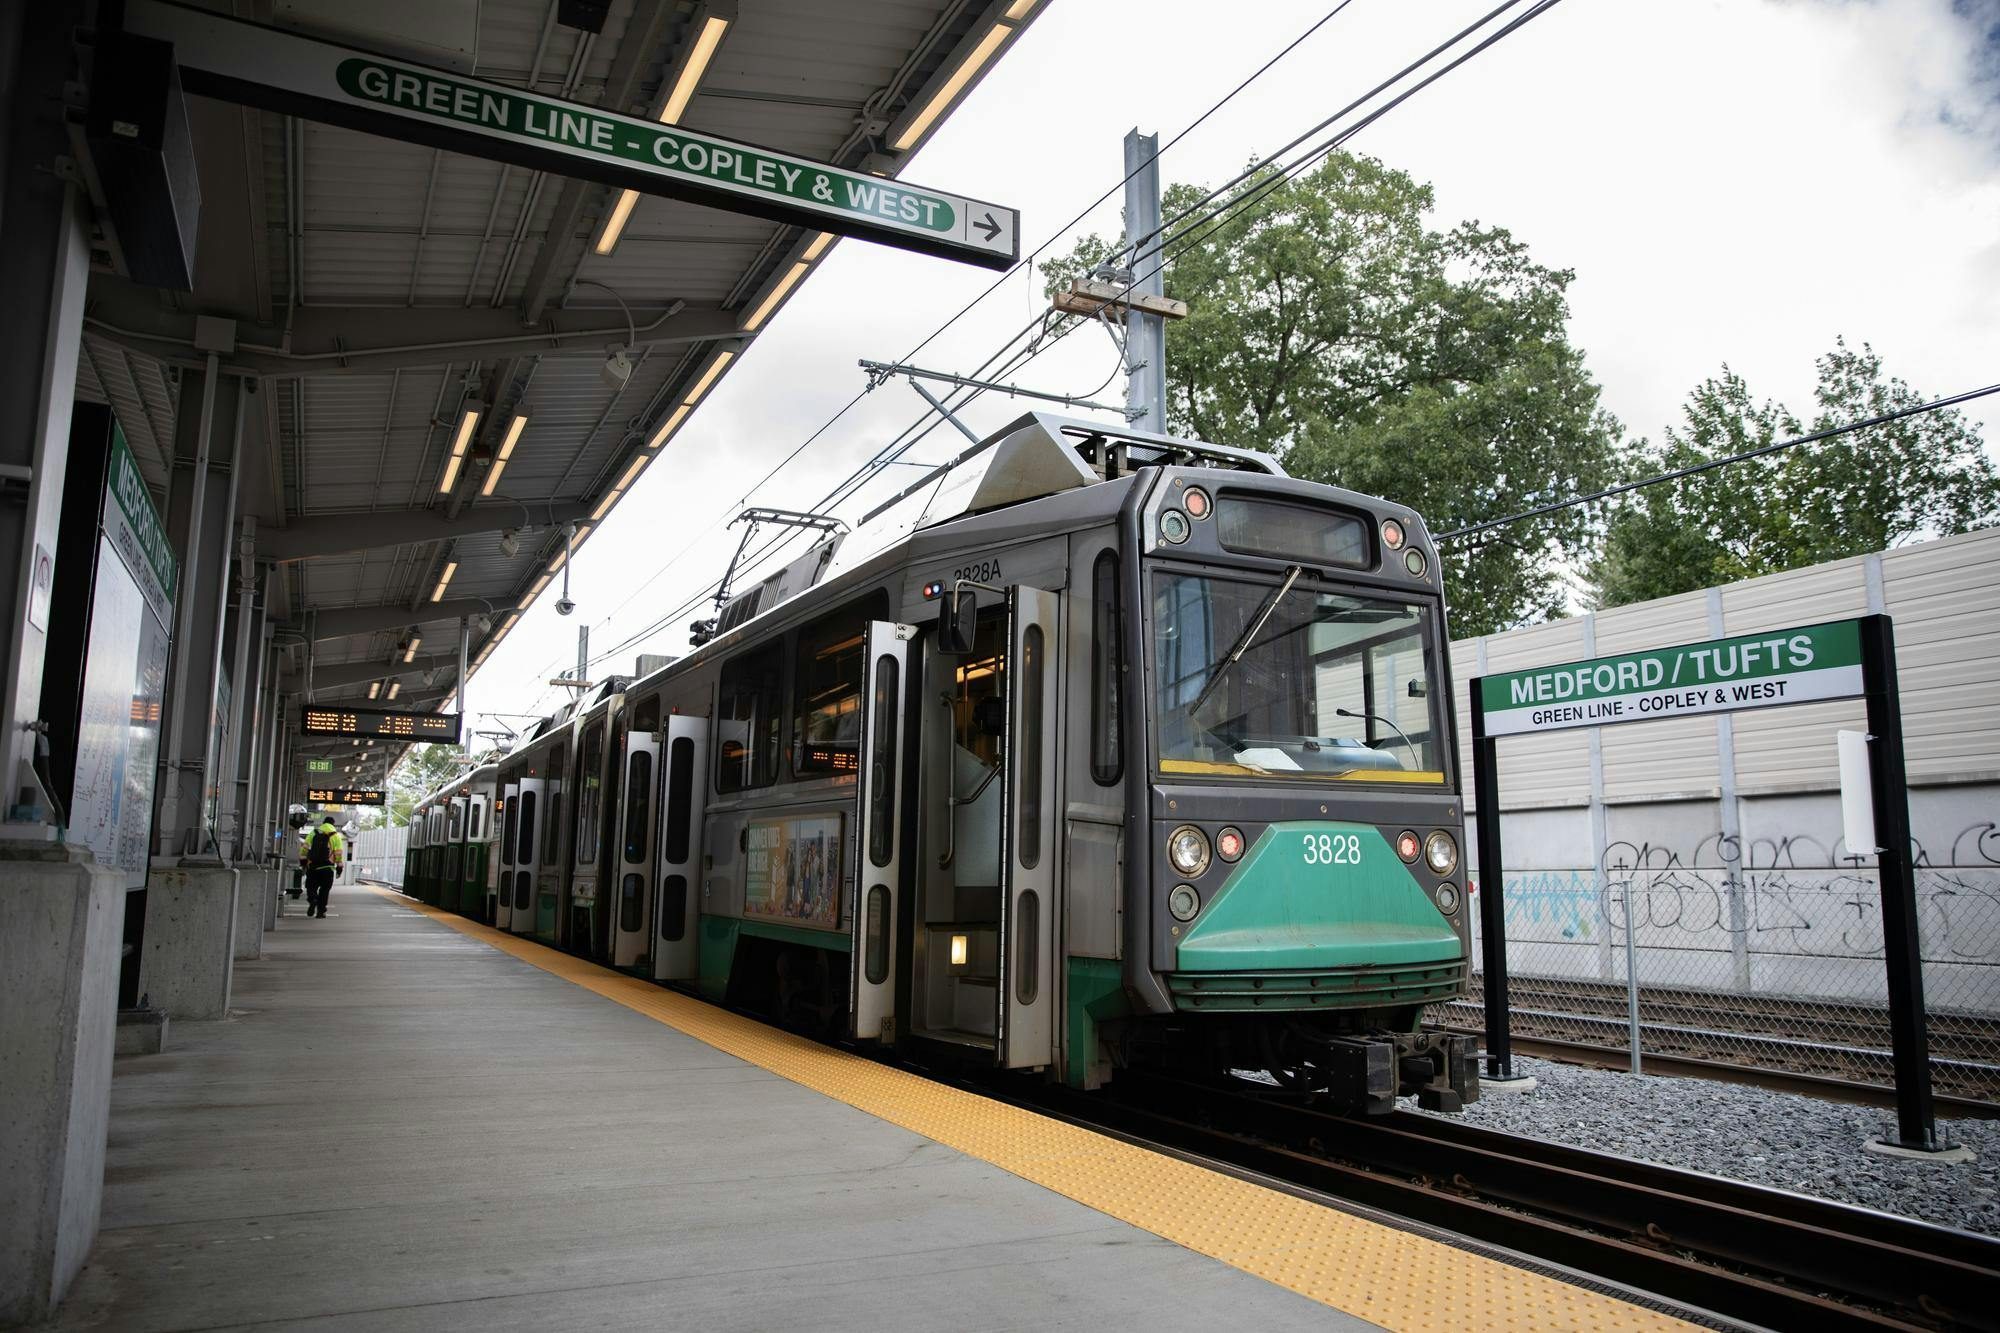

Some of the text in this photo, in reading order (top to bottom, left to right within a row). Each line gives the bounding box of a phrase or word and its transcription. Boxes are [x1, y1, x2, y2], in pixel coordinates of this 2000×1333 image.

[358, 67, 941, 226] GREEN LINE - COPLEY & WEST
[1532, 706, 1583, 724] GREEN
[1588, 701, 1623, 718] LINE
[1639, 690, 1708, 712] COPLEY
[1714, 688, 1726, 703] &
[1732, 681, 1787, 701] WEST
[1303, 834, 1361, 864] 3828
